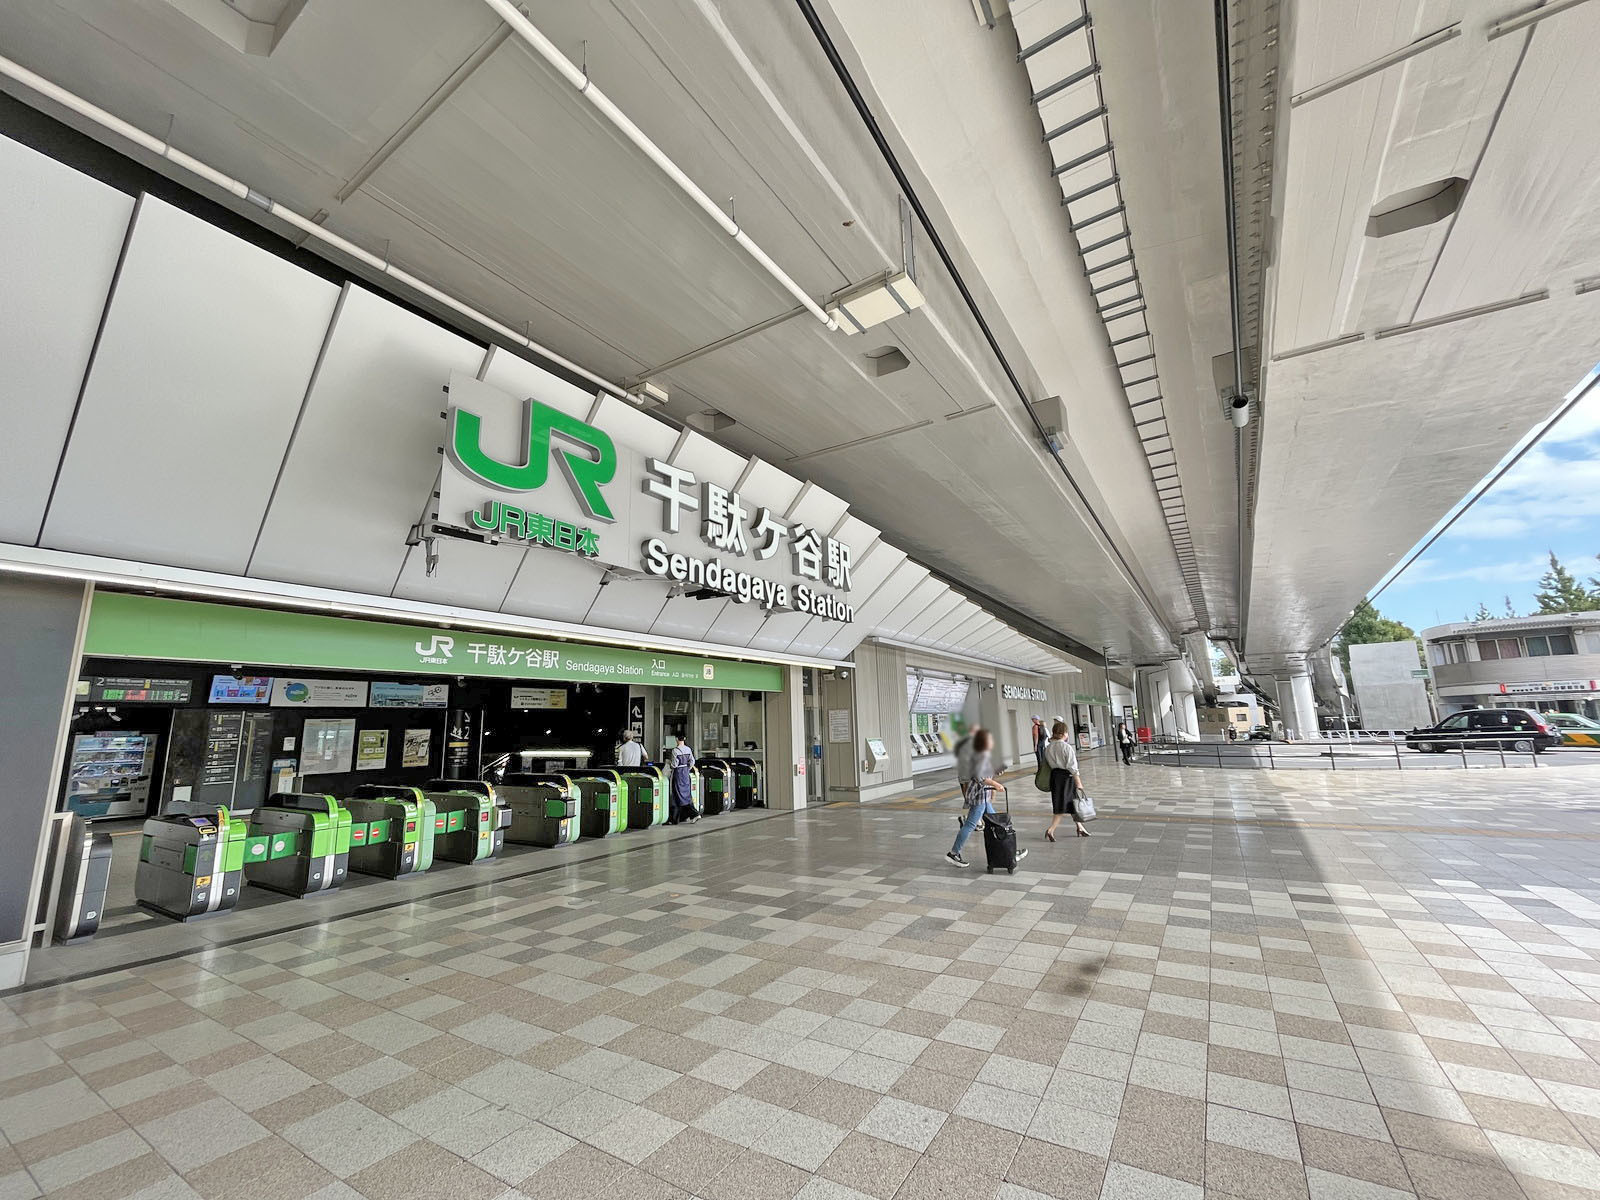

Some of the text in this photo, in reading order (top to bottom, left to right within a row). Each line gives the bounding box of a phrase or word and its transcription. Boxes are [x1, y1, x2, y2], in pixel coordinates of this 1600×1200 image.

[448, 398, 617, 523] JR
[470, 500, 600, 556] JR東日本
[643, 539, 855, 623] Sendagaya Station
[415, 635, 454, 658] JR
[419, 656, 449, 665] JR東日本
[565, 660, 644, 676] Sendagaya Station
[651, 659, 666, 669] 入口
[96, 677, 105, 686] 2
[1002, 684, 1048, 701] SENDAGAYA STATION
[463, 726, 470, 740] 2
